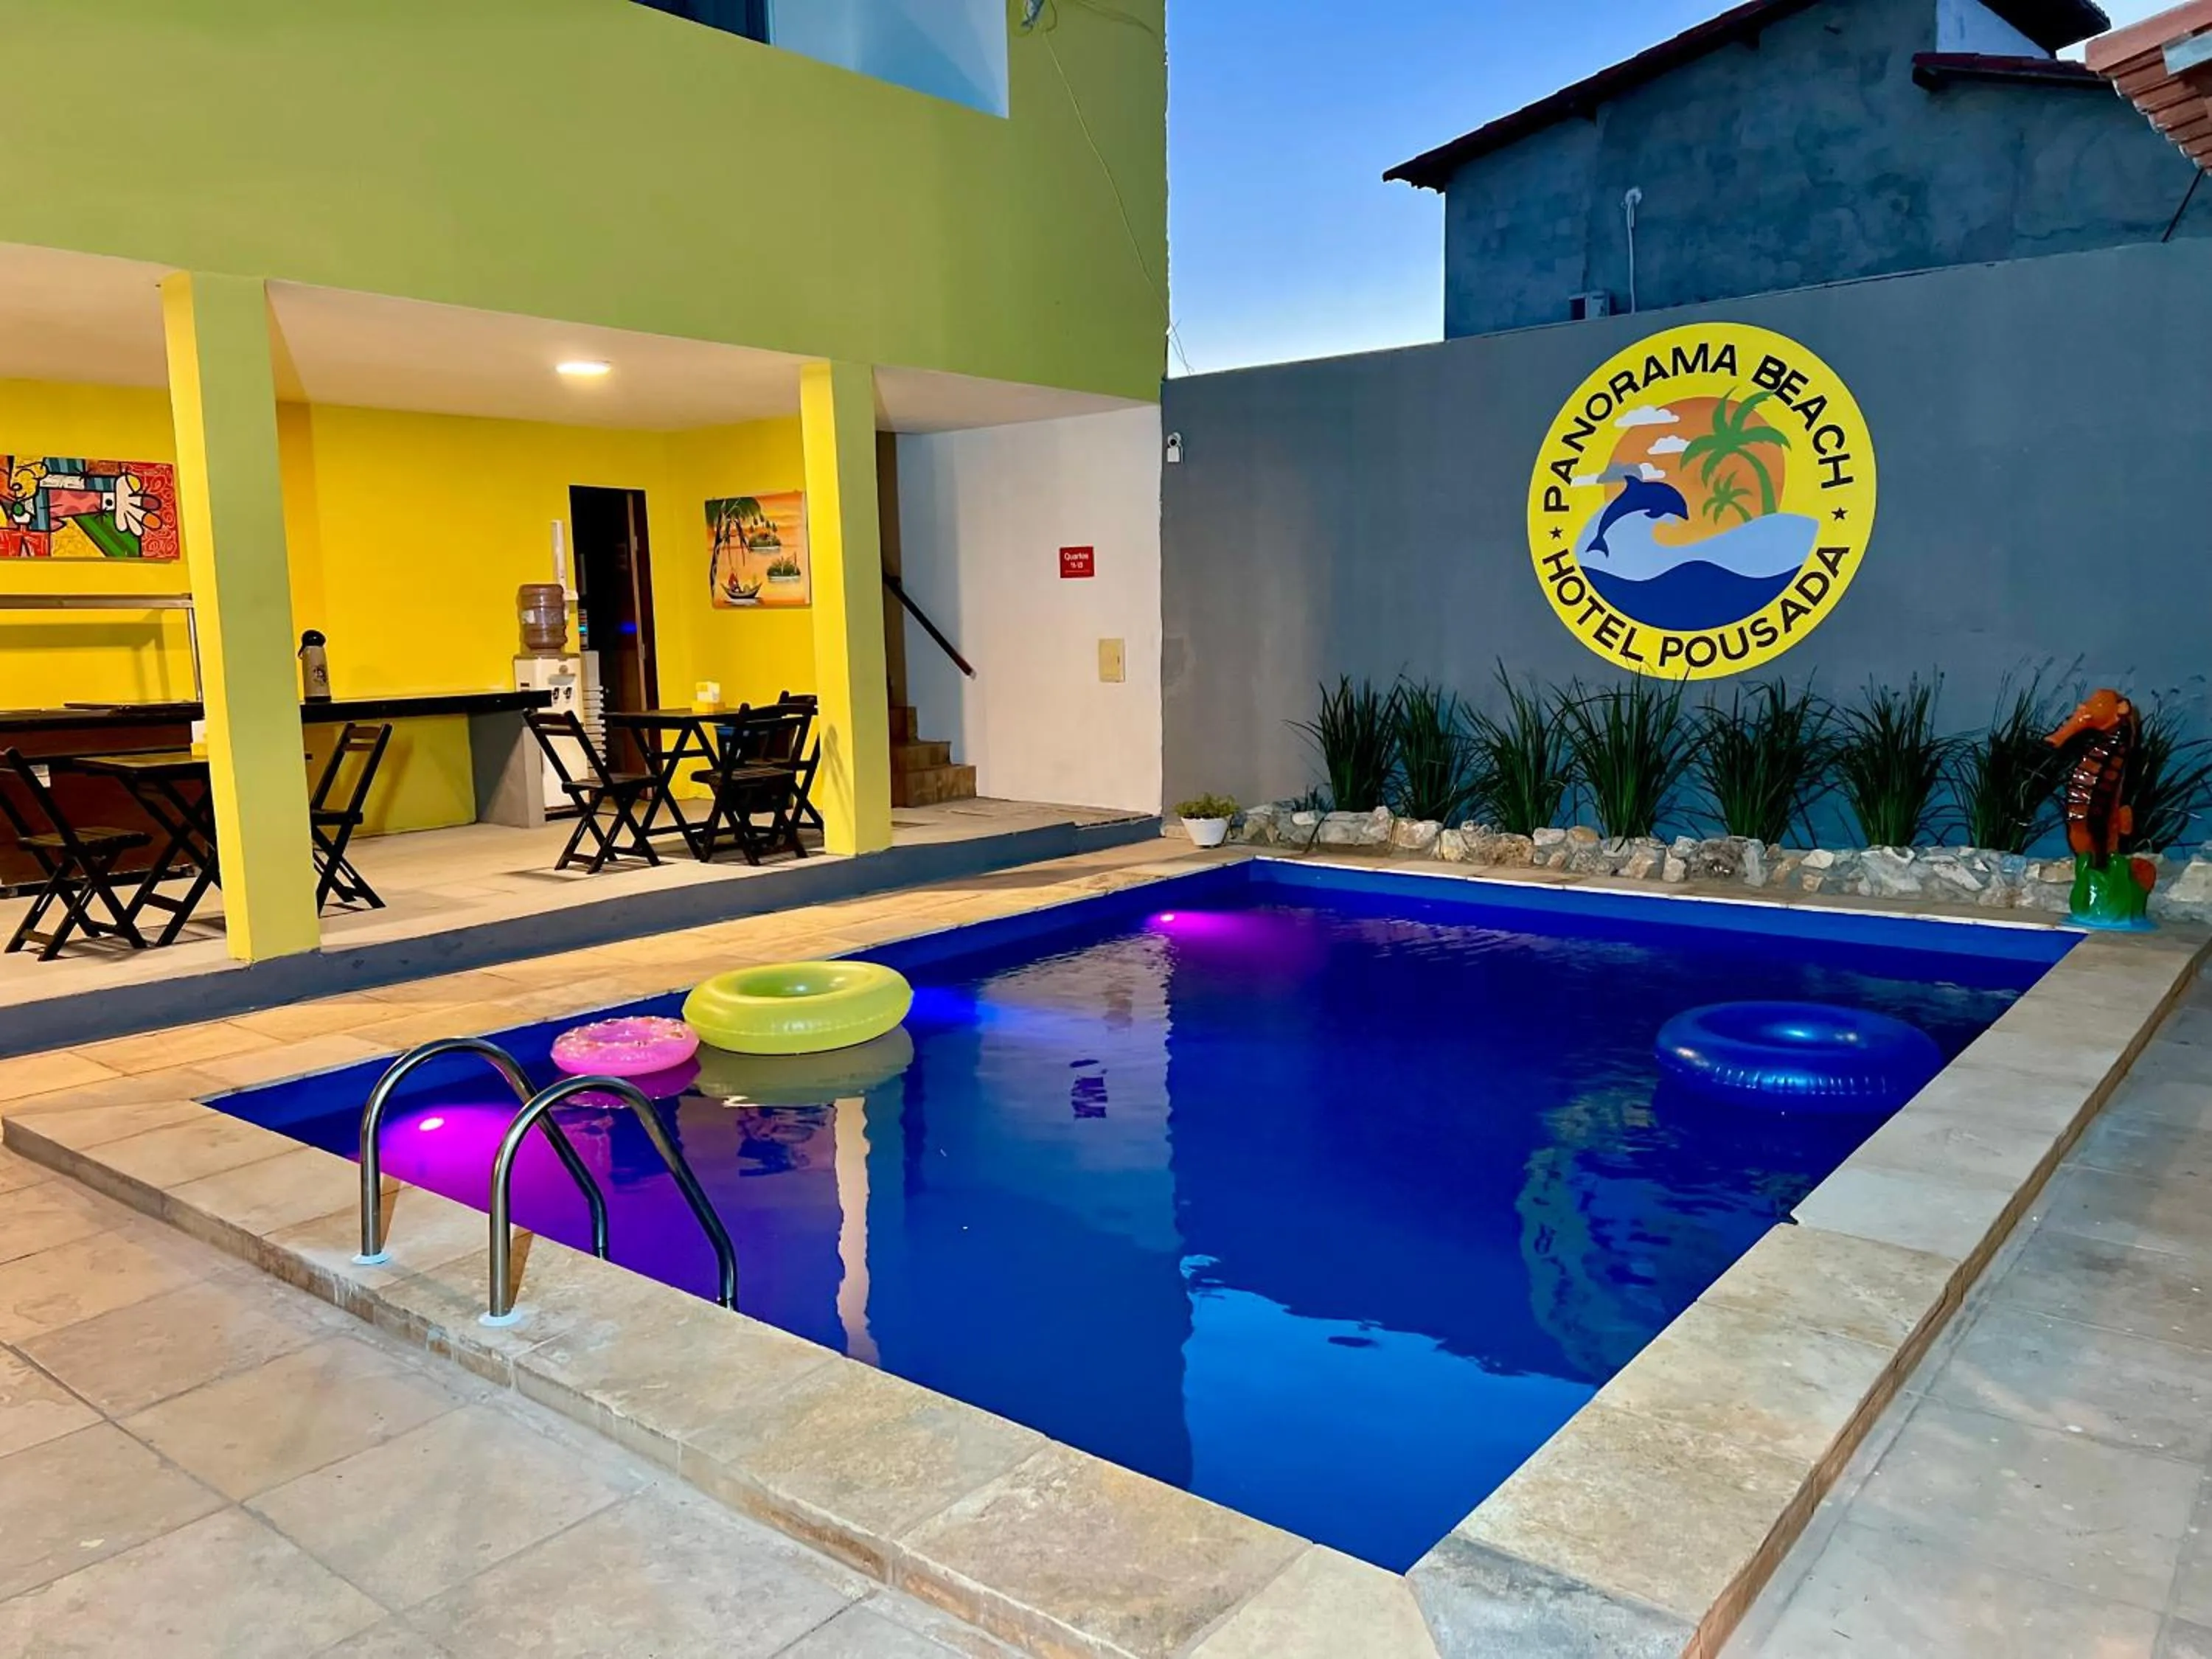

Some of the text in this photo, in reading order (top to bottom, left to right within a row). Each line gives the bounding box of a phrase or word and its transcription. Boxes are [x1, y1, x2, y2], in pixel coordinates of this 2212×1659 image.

[1543, 342, 1854, 513] PANORAMA BEACH
[1542, 544, 1851, 668] HOTEL POUSADA
